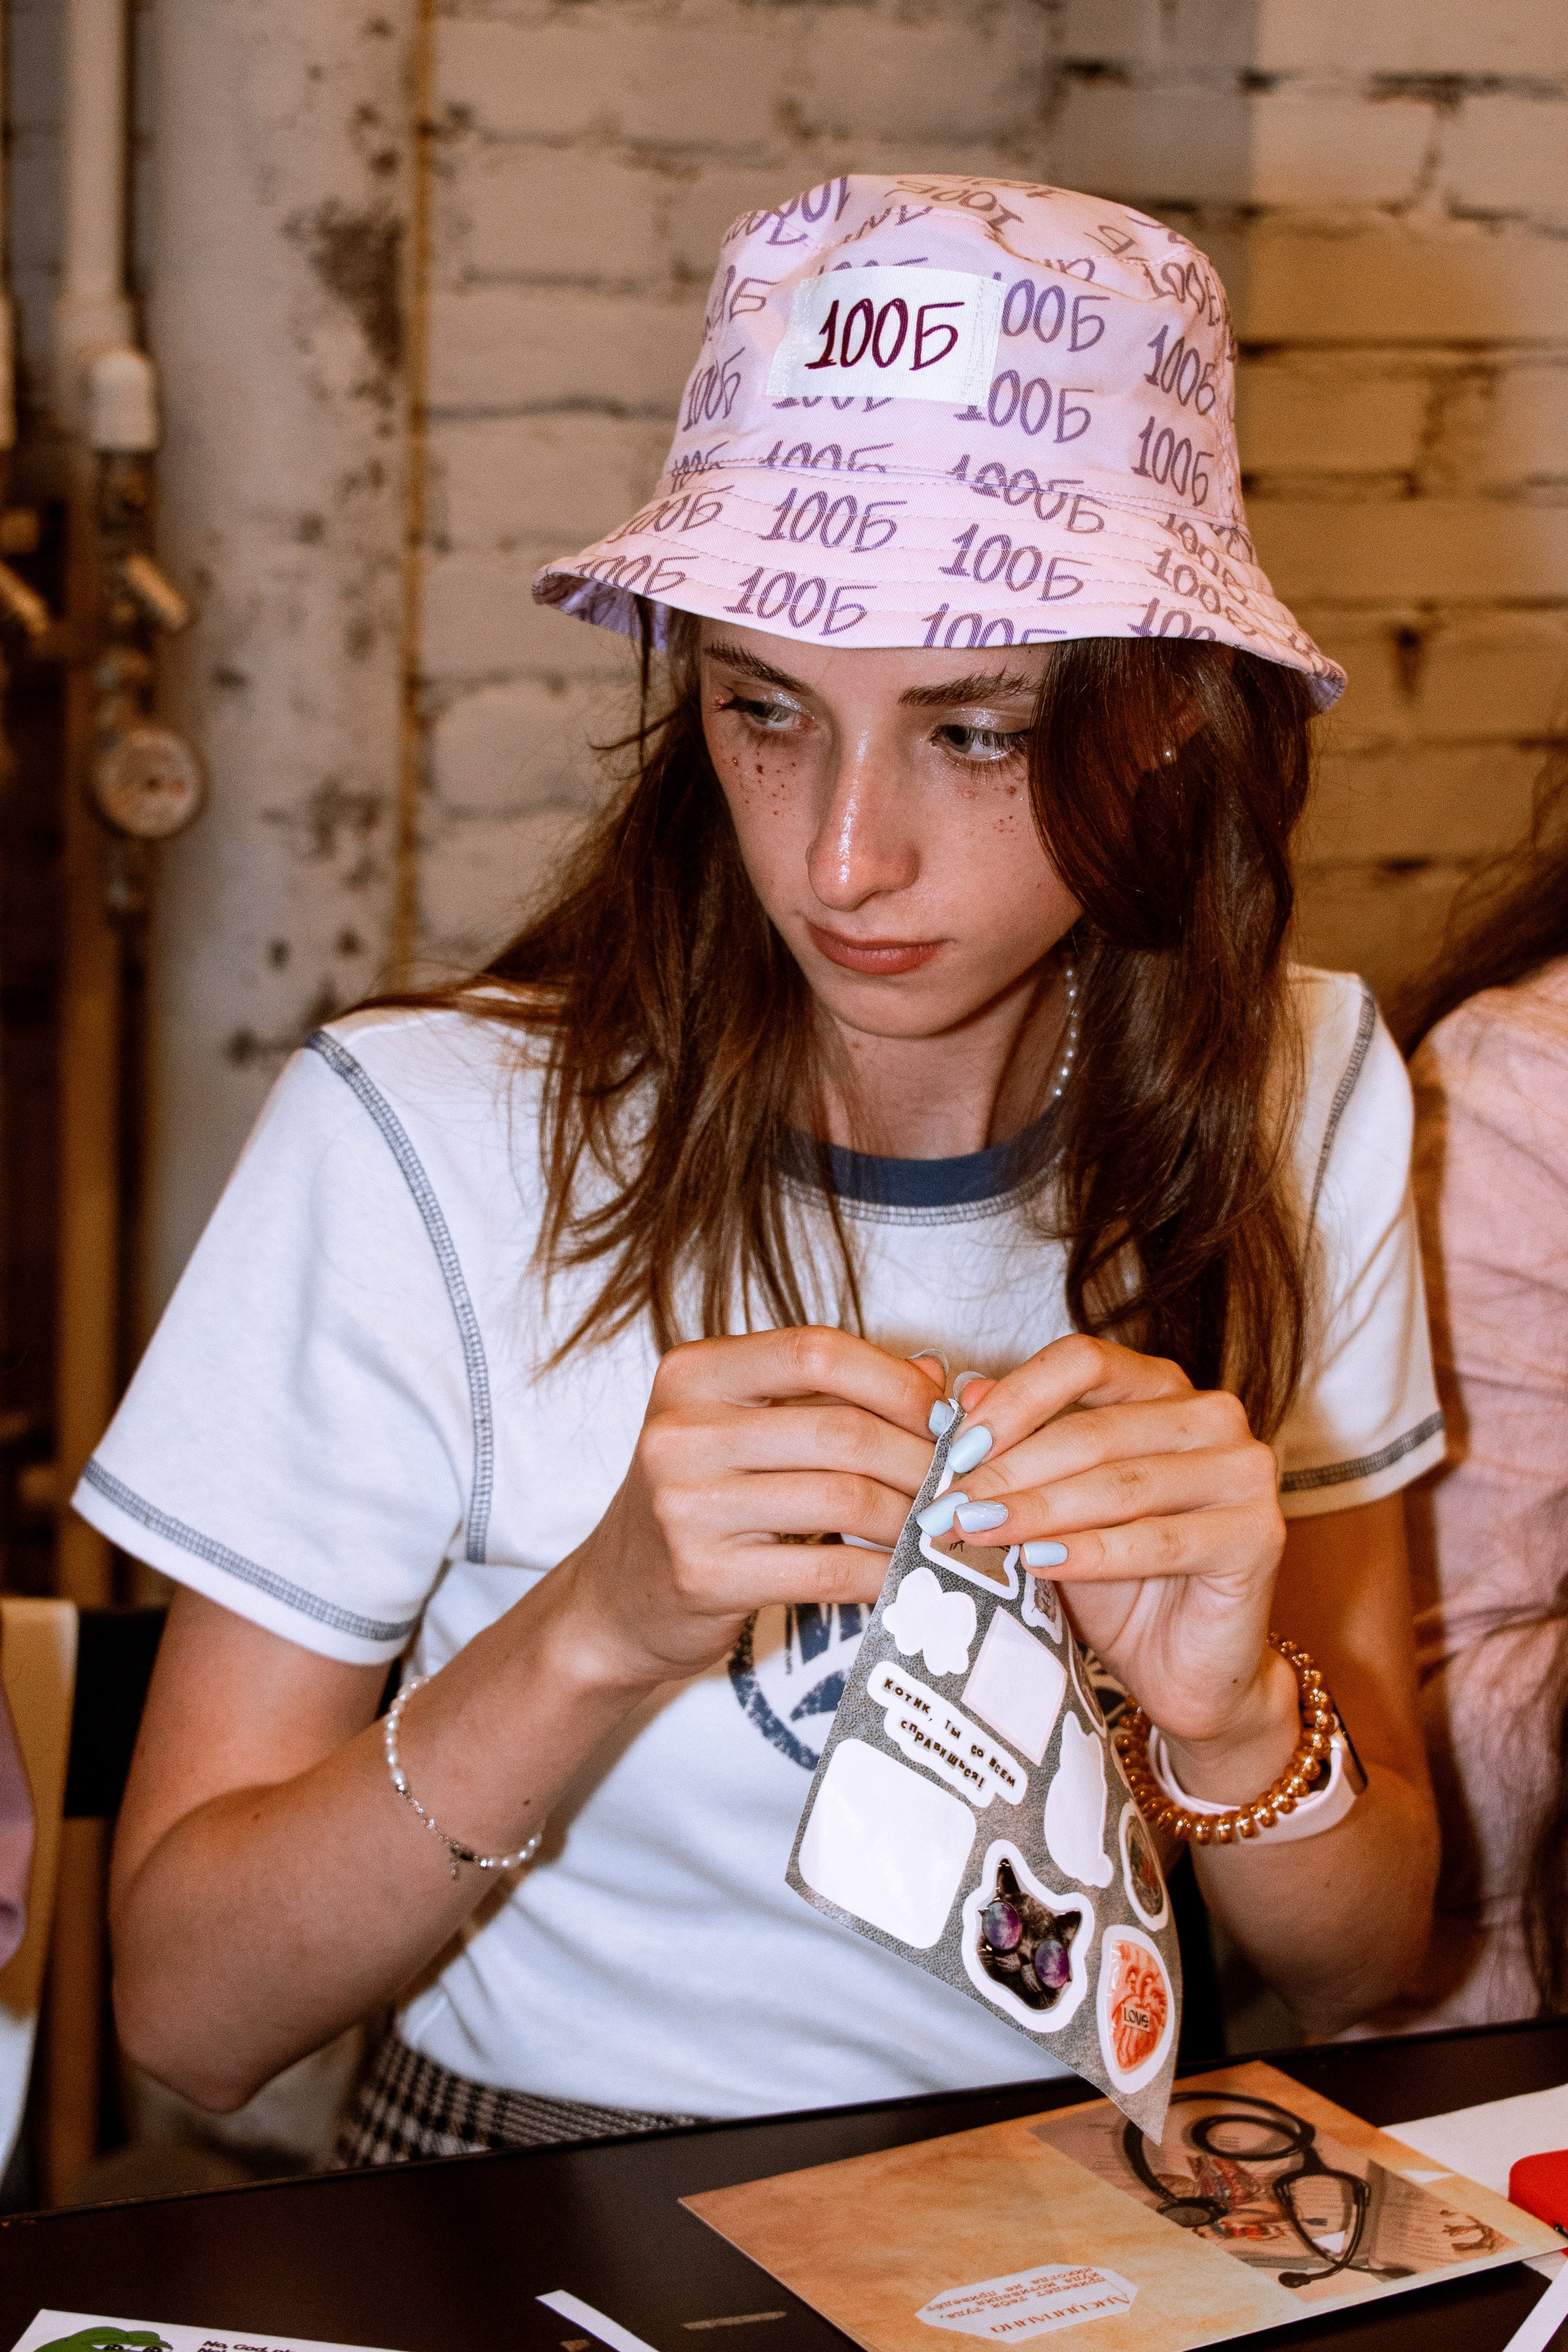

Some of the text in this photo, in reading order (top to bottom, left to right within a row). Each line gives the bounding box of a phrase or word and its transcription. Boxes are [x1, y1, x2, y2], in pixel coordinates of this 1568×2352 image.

[805, 298, 965, 371] 100Б
[1131, 416, 1214, 505] 100Б
[758, 488, 908, 553] 100Б
[939, 524, 1092, 601] 100Б
[725, 567, 877, 636] 100Б
